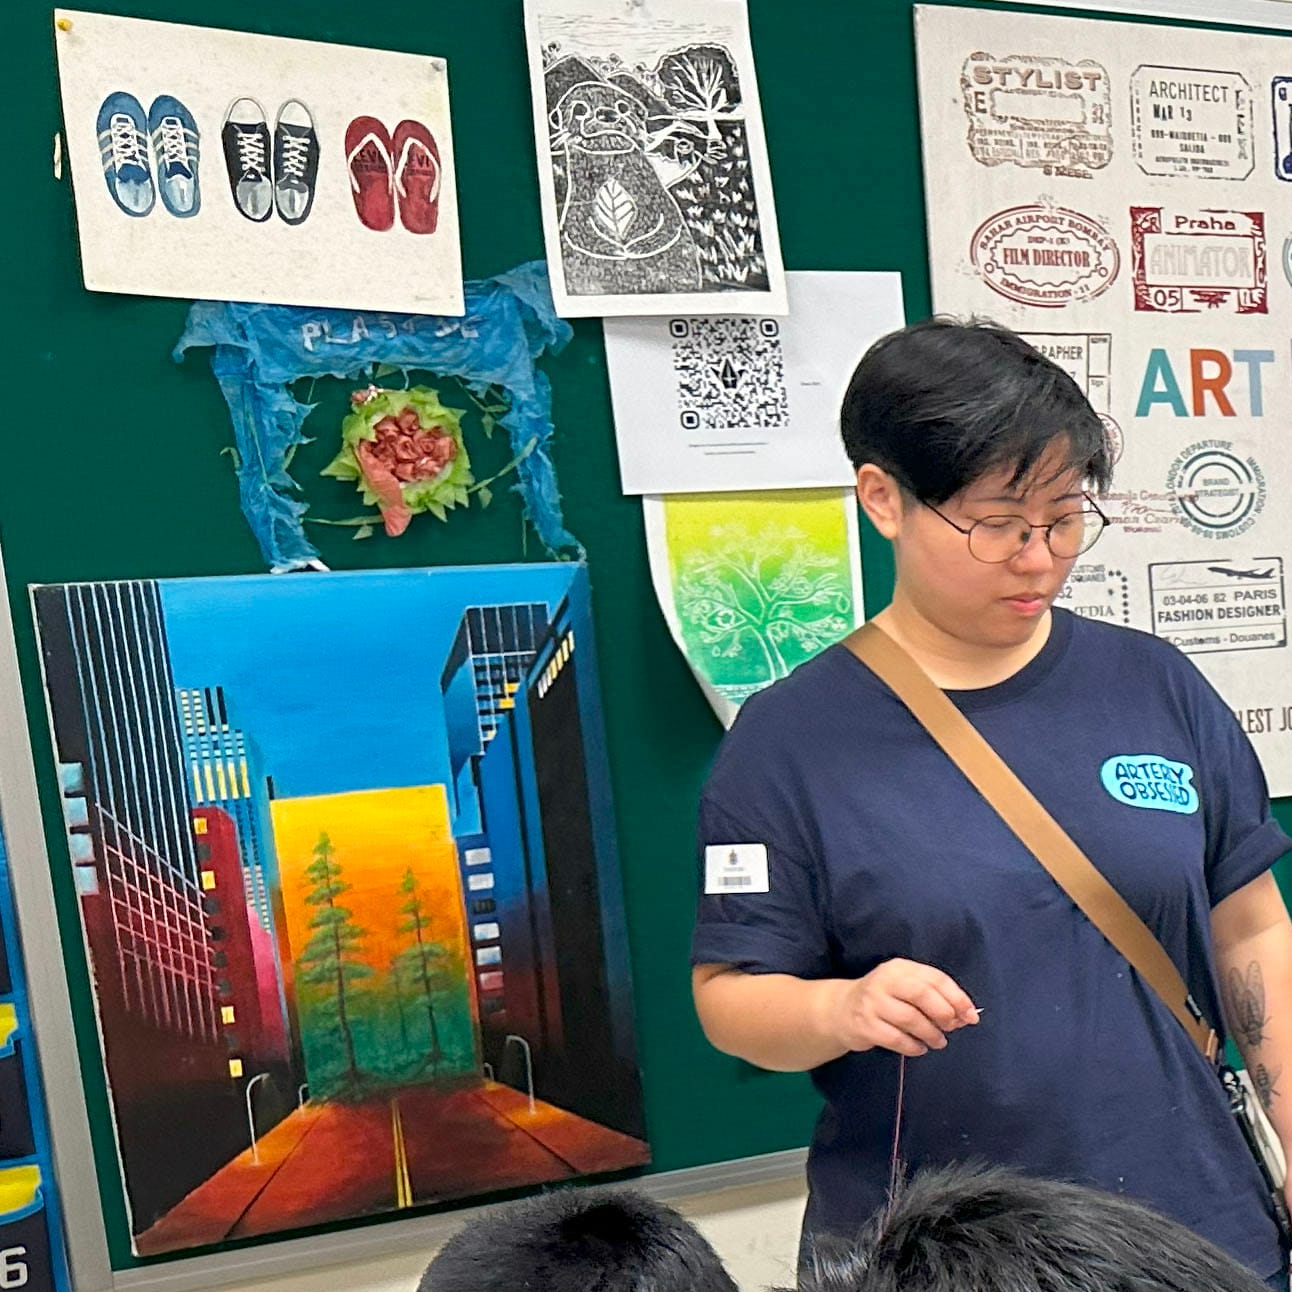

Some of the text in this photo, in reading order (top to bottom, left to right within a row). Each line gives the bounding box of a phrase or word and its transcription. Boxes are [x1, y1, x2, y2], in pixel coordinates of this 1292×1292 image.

[973, 65, 1102, 92] STYLIST
[1149, 80, 1229, 104] ARCHITECT
[1153, 104, 1173, 121] MAR
[1015, 213, 1065, 227] AIRPORT
[1174, 215, 1237, 231] Praha
[1003, 247, 1091, 268] FILM DIRECTOR
[1149, 243, 1253, 279] ANIMATOR
[1135, 347, 1275, 418] ART
[1234, 589, 1278, 601] PARIS
[1157, 605, 1281, 624] FASHION DESIGNER
[1229, 631, 1276, 644] Douanes
[1236, 707, 1274, 734] LEST
